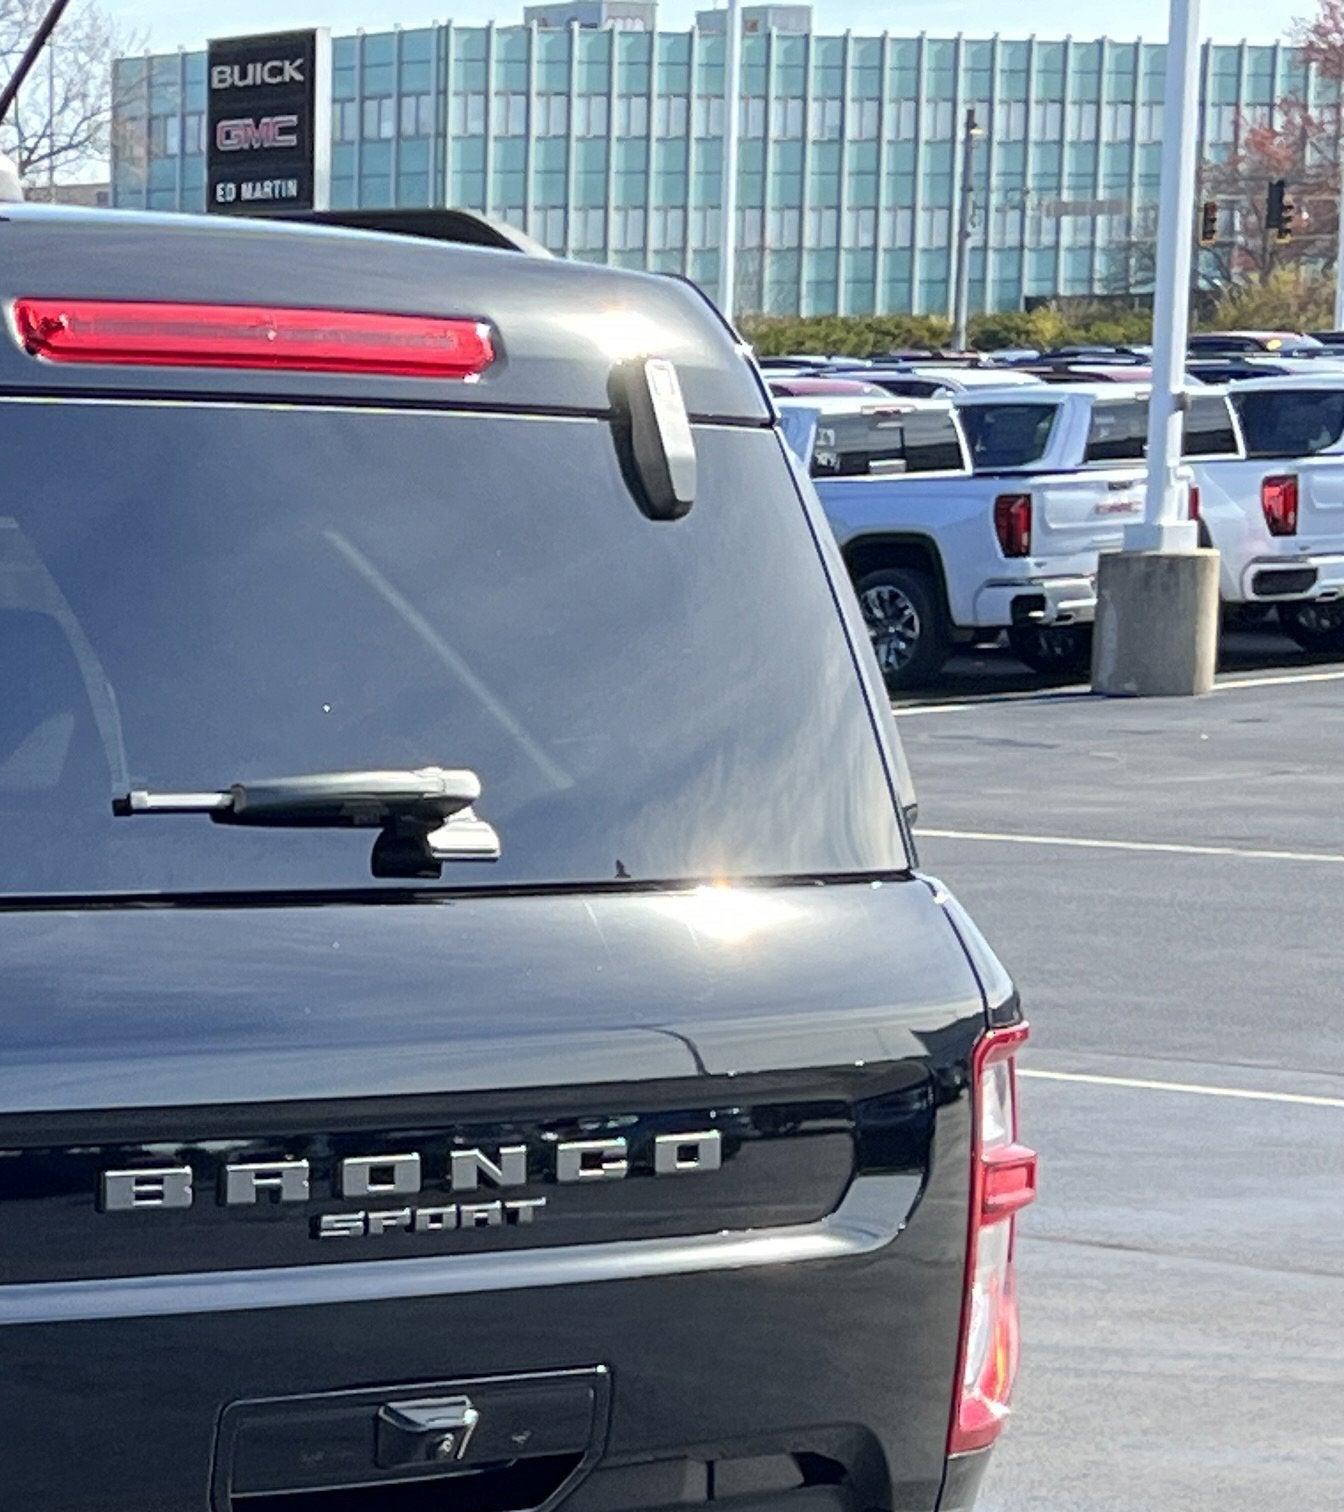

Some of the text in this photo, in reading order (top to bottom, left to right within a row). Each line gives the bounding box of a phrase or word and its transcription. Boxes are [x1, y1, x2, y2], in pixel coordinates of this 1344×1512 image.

[211, 58, 304, 89] BUICK
[216, 115, 298, 151] GMC
[216, 179, 298, 203] ED MARTIN
[103, 1128, 722, 1211] BRONCO
[317, 1196, 547, 1239] SPORT
